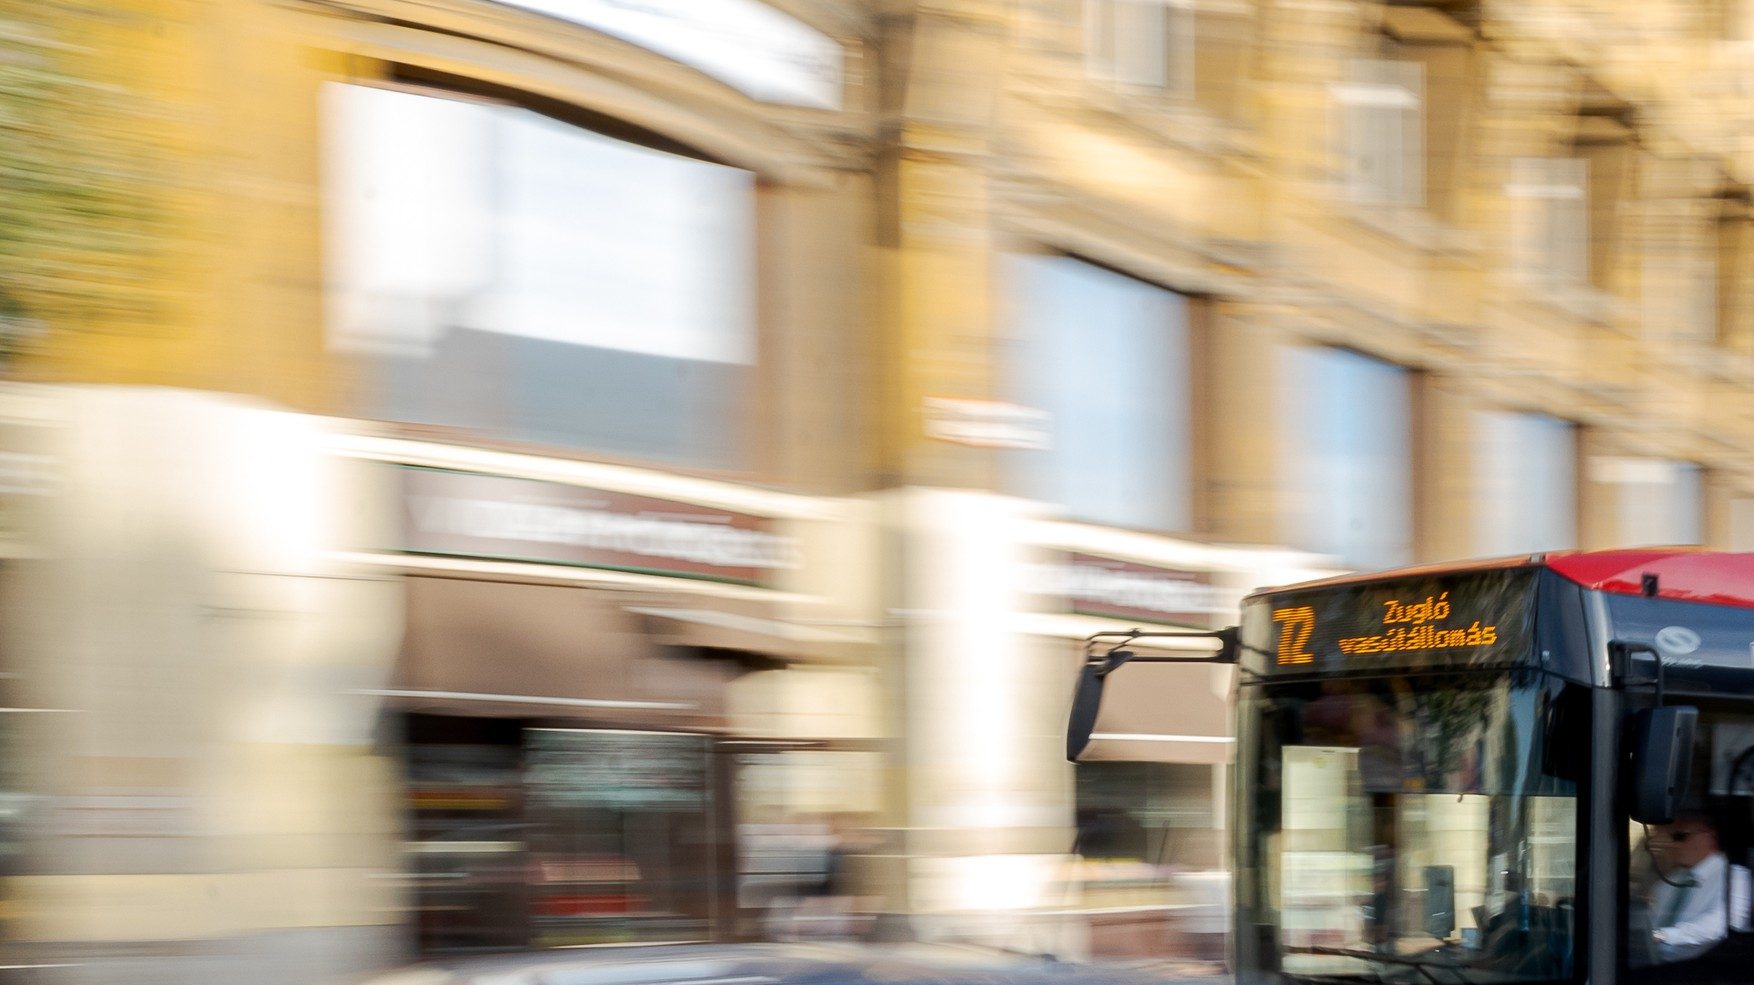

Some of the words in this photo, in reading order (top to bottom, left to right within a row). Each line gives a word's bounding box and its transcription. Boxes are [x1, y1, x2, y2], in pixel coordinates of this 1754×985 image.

[1383, 592, 1450, 624] Zugló
[1272, 605, 1315, 665] 72
[1338, 620, 1498, 655] vasútállomás
